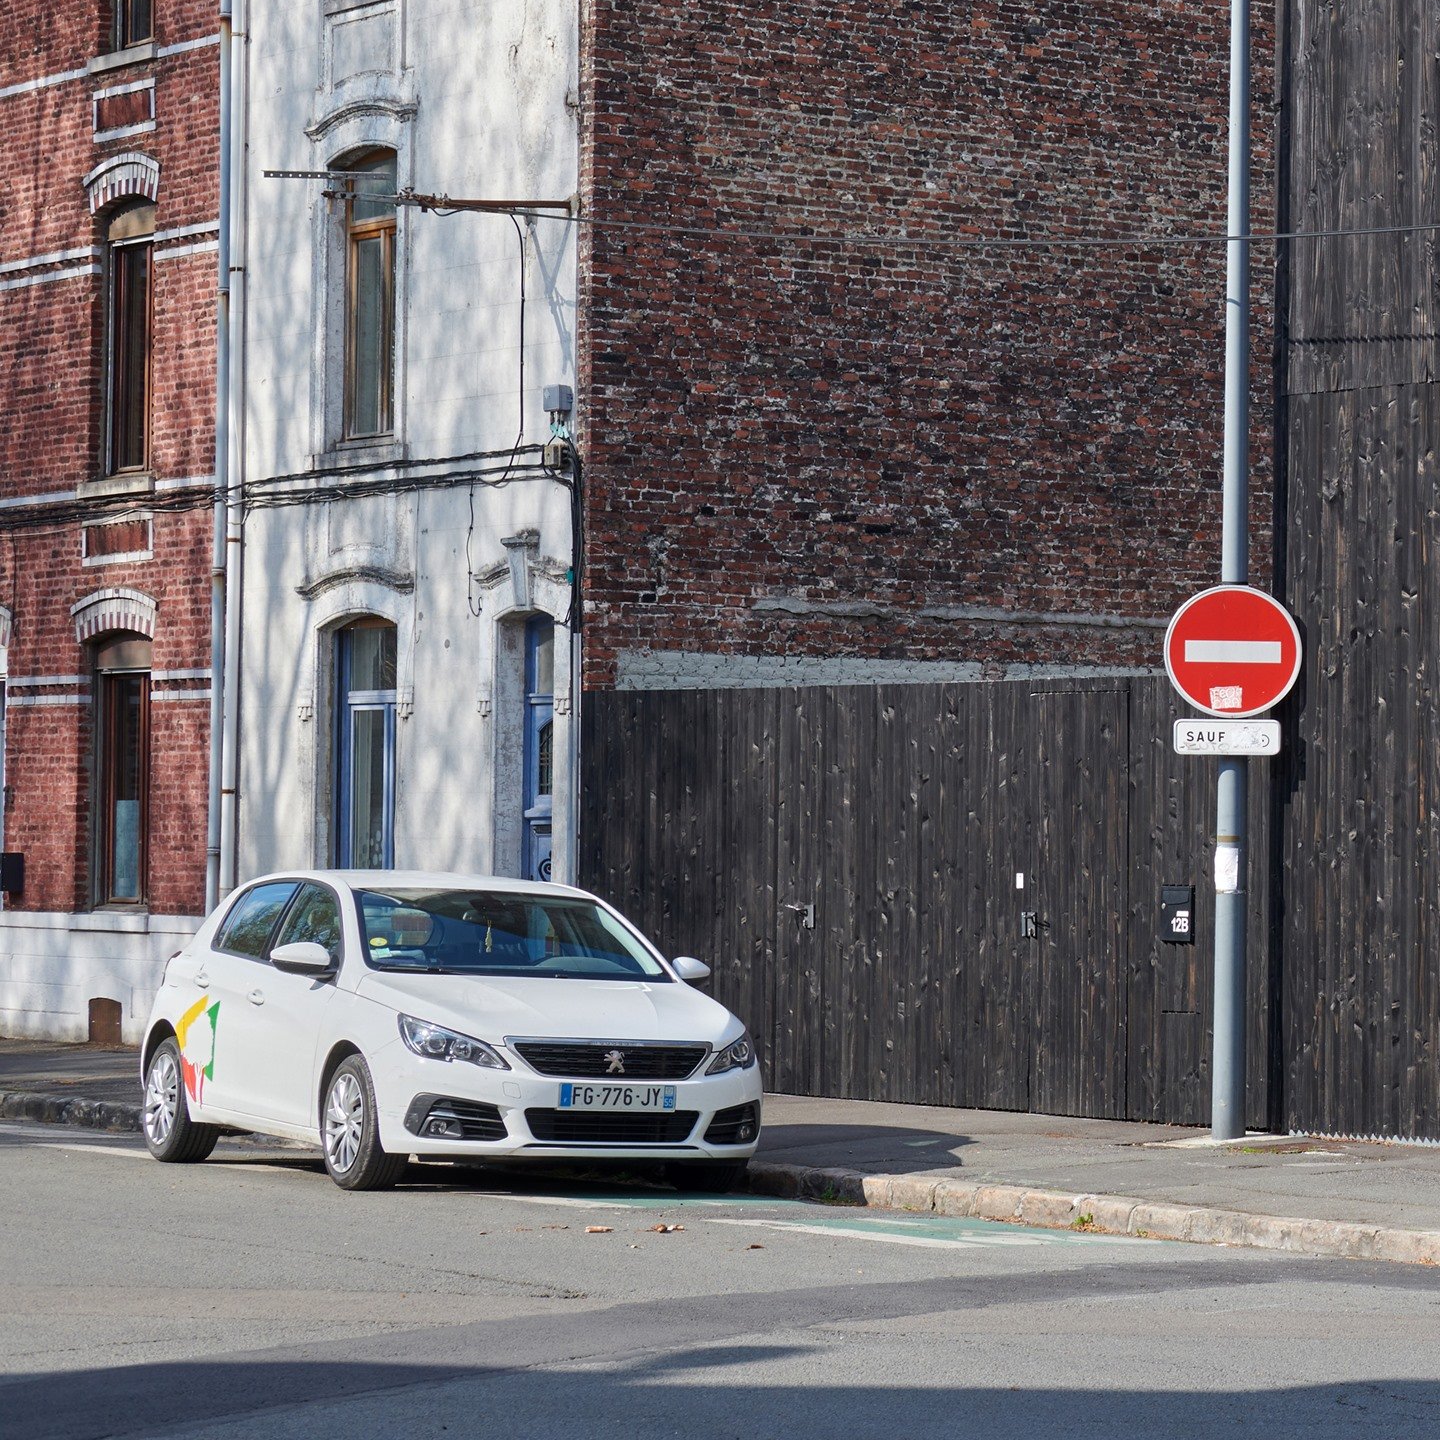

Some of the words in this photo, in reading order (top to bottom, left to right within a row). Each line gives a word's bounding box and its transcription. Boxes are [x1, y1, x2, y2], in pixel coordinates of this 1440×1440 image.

[1186, 731, 1225, 742] SAUF
[1171, 917, 1188, 932] 12B
[572, 1087, 660, 1106] FG-776-JY
[664, 1098, 673, 1107] 59
